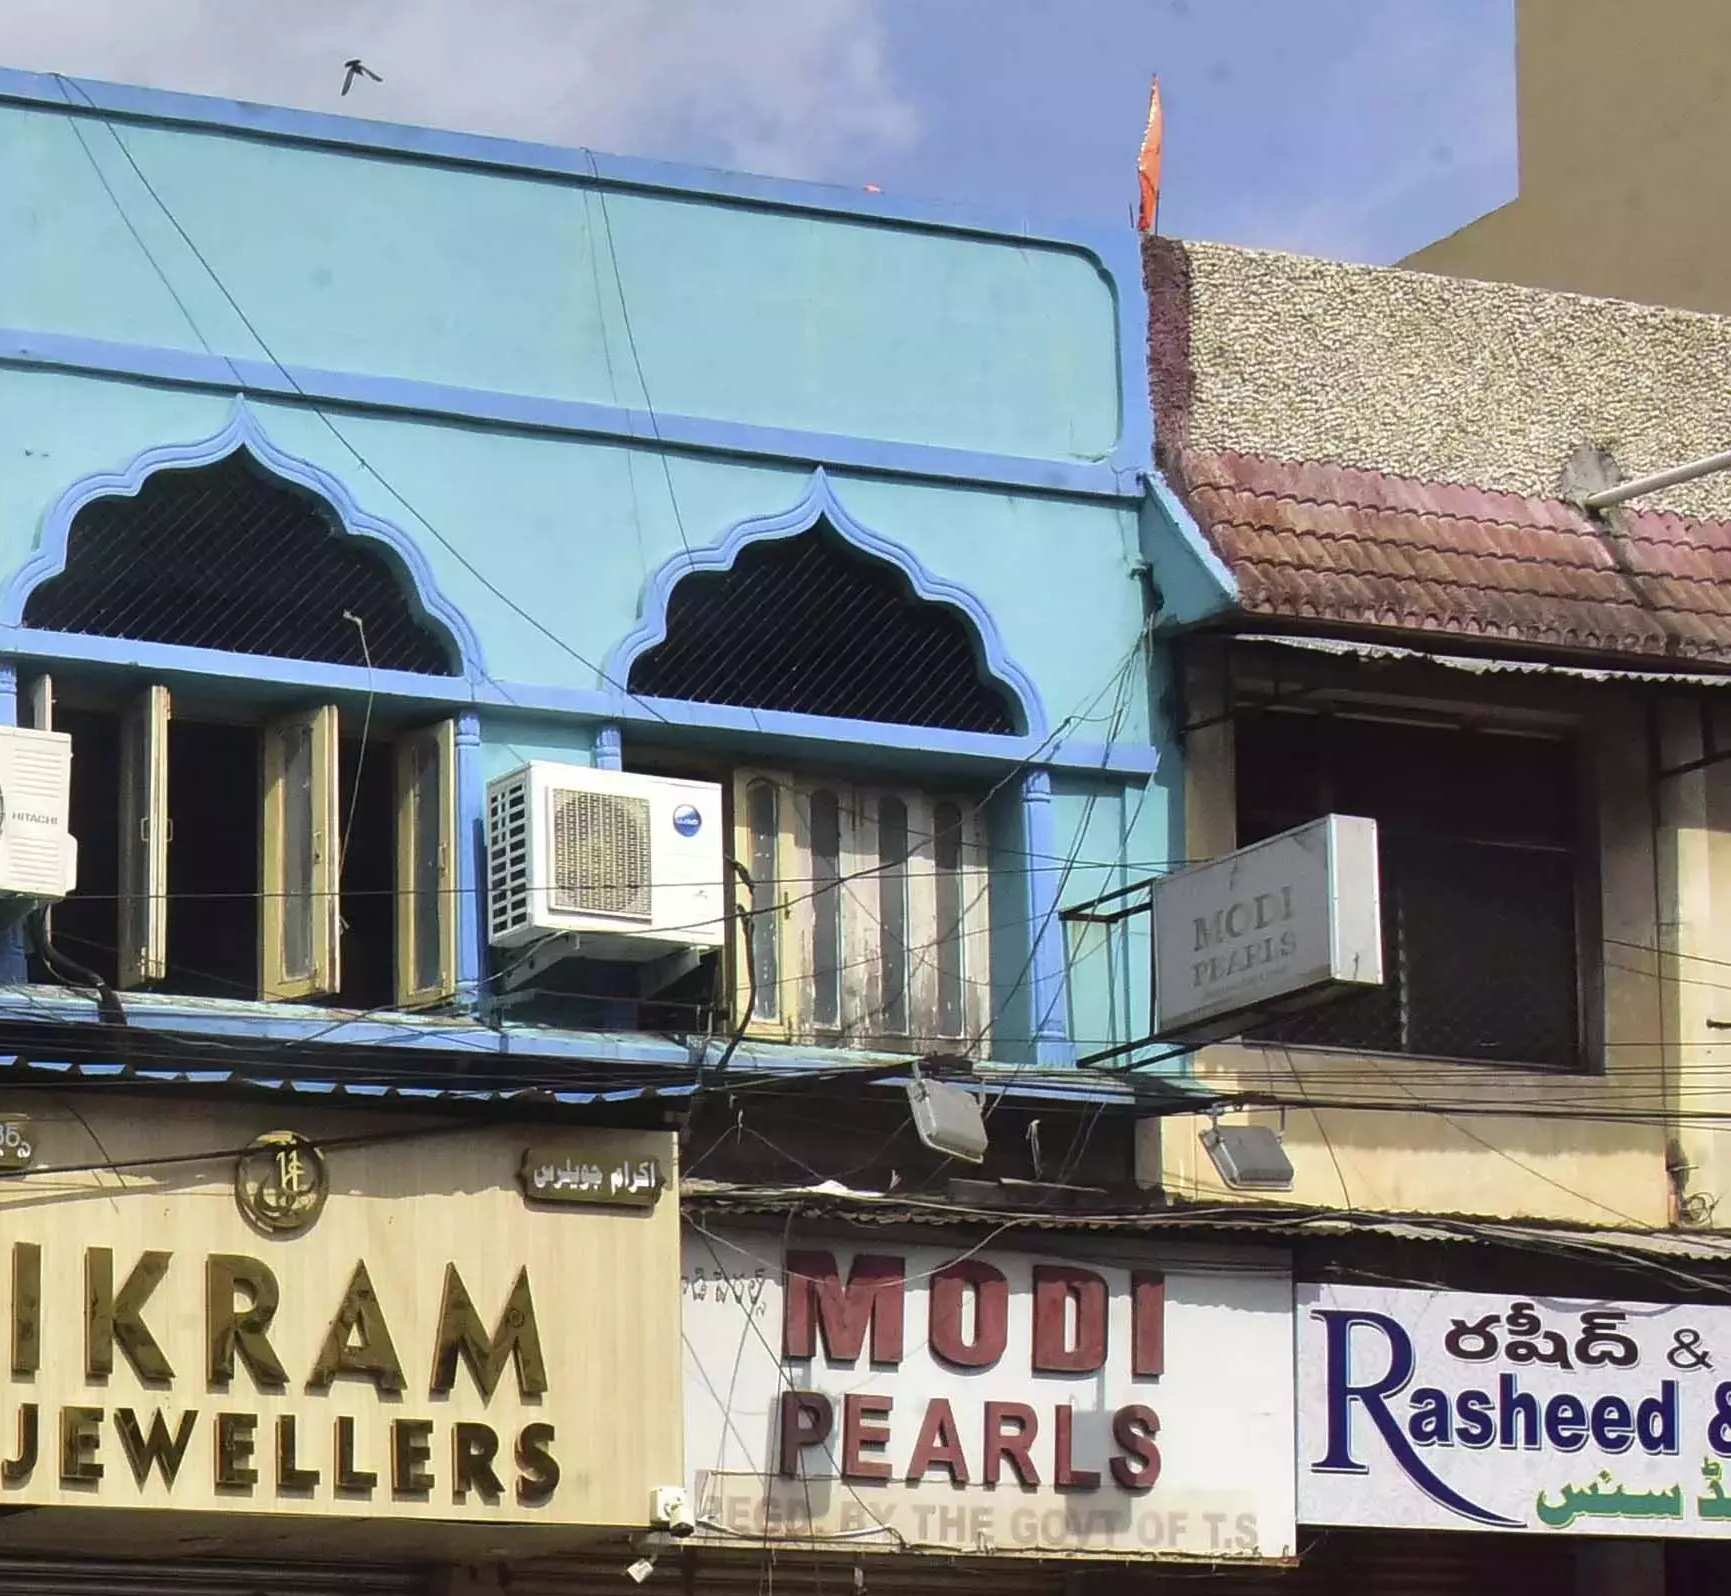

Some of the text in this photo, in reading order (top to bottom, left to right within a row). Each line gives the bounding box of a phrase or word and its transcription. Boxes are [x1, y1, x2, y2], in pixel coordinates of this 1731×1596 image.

[11, 811, 59, 825] HITACHI
[1192, 885, 1294, 952] MODI
[11, 1240, 549, 1405] IKRAM
[781, 1248, 1166, 1378] MODI
[1444, 1301, 1714, 1371] రషీద్ &
[1, 1401, 562, 1505] JEWELLERS
[777, 1391, 1162, 1493] PEARLS
[1310, 1309, 1682, 1528] Rasheed
[839, 1500, 899, 1532] BY
[911, 1504, 995, 1542] THE
[1010, 1507, 1123, 1545] GOVT
[1137, 1511, 1190, 1546] OF
